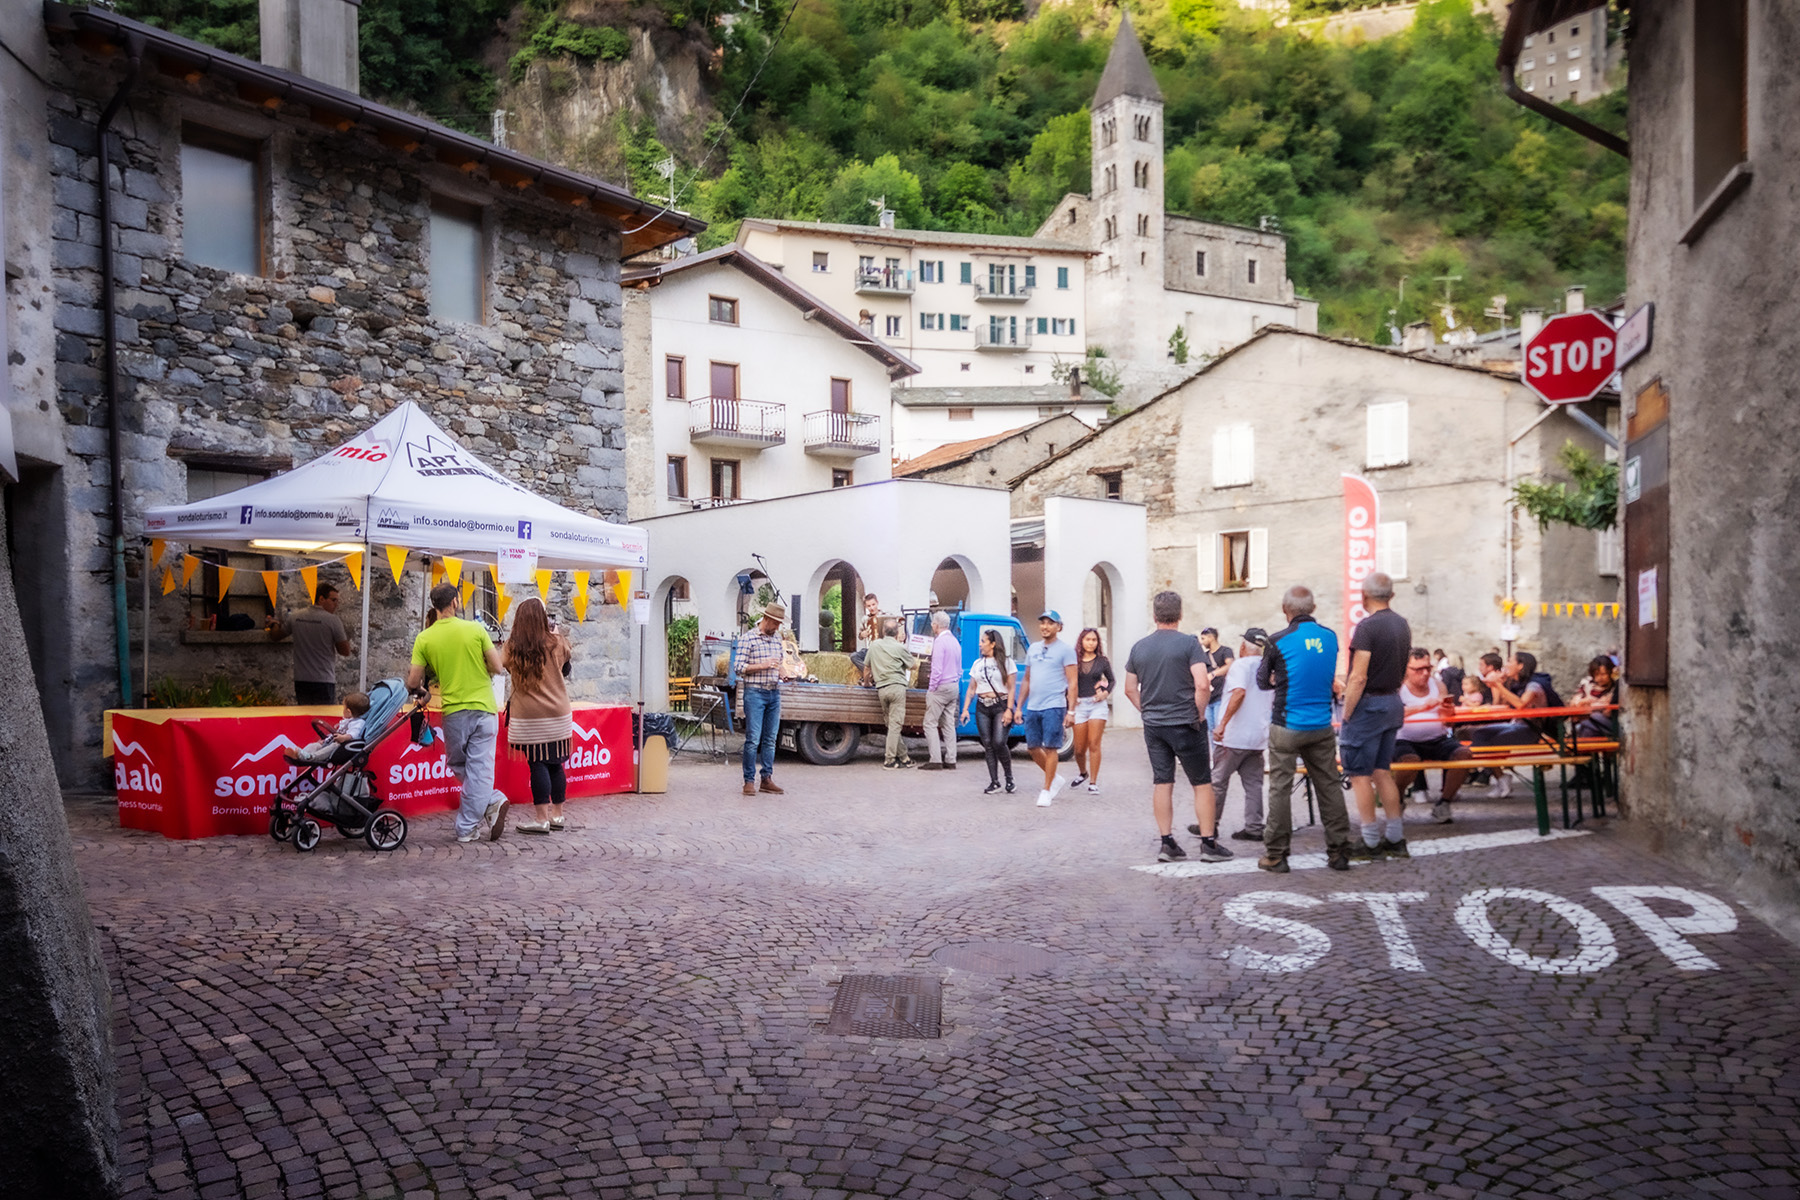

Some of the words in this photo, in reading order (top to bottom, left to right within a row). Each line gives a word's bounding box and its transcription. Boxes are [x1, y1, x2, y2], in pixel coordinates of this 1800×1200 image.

[1528, 336, 1614, 378] STOP
[417, 454, 462, 468] APT
[177, 511, 228, 522] sondaloturismo.it
[254, 508, 334, 521] info.sondalo@bormio.eu
[413, 515, 515, 533] info.sondalo@bormio.eu
[550, 530, 610, 545] sondaloturismo.it
[115, 762, 162, 794] dalo
[584, 772, 610, 781] mountain
[414, 789, 424, 797] the
[424, 786, 449, 796] wellness
[212, 806, 251, 815] Bormio,
[253, 805, 267, 813] the
[1219, 886, 1738, 974] STOP
